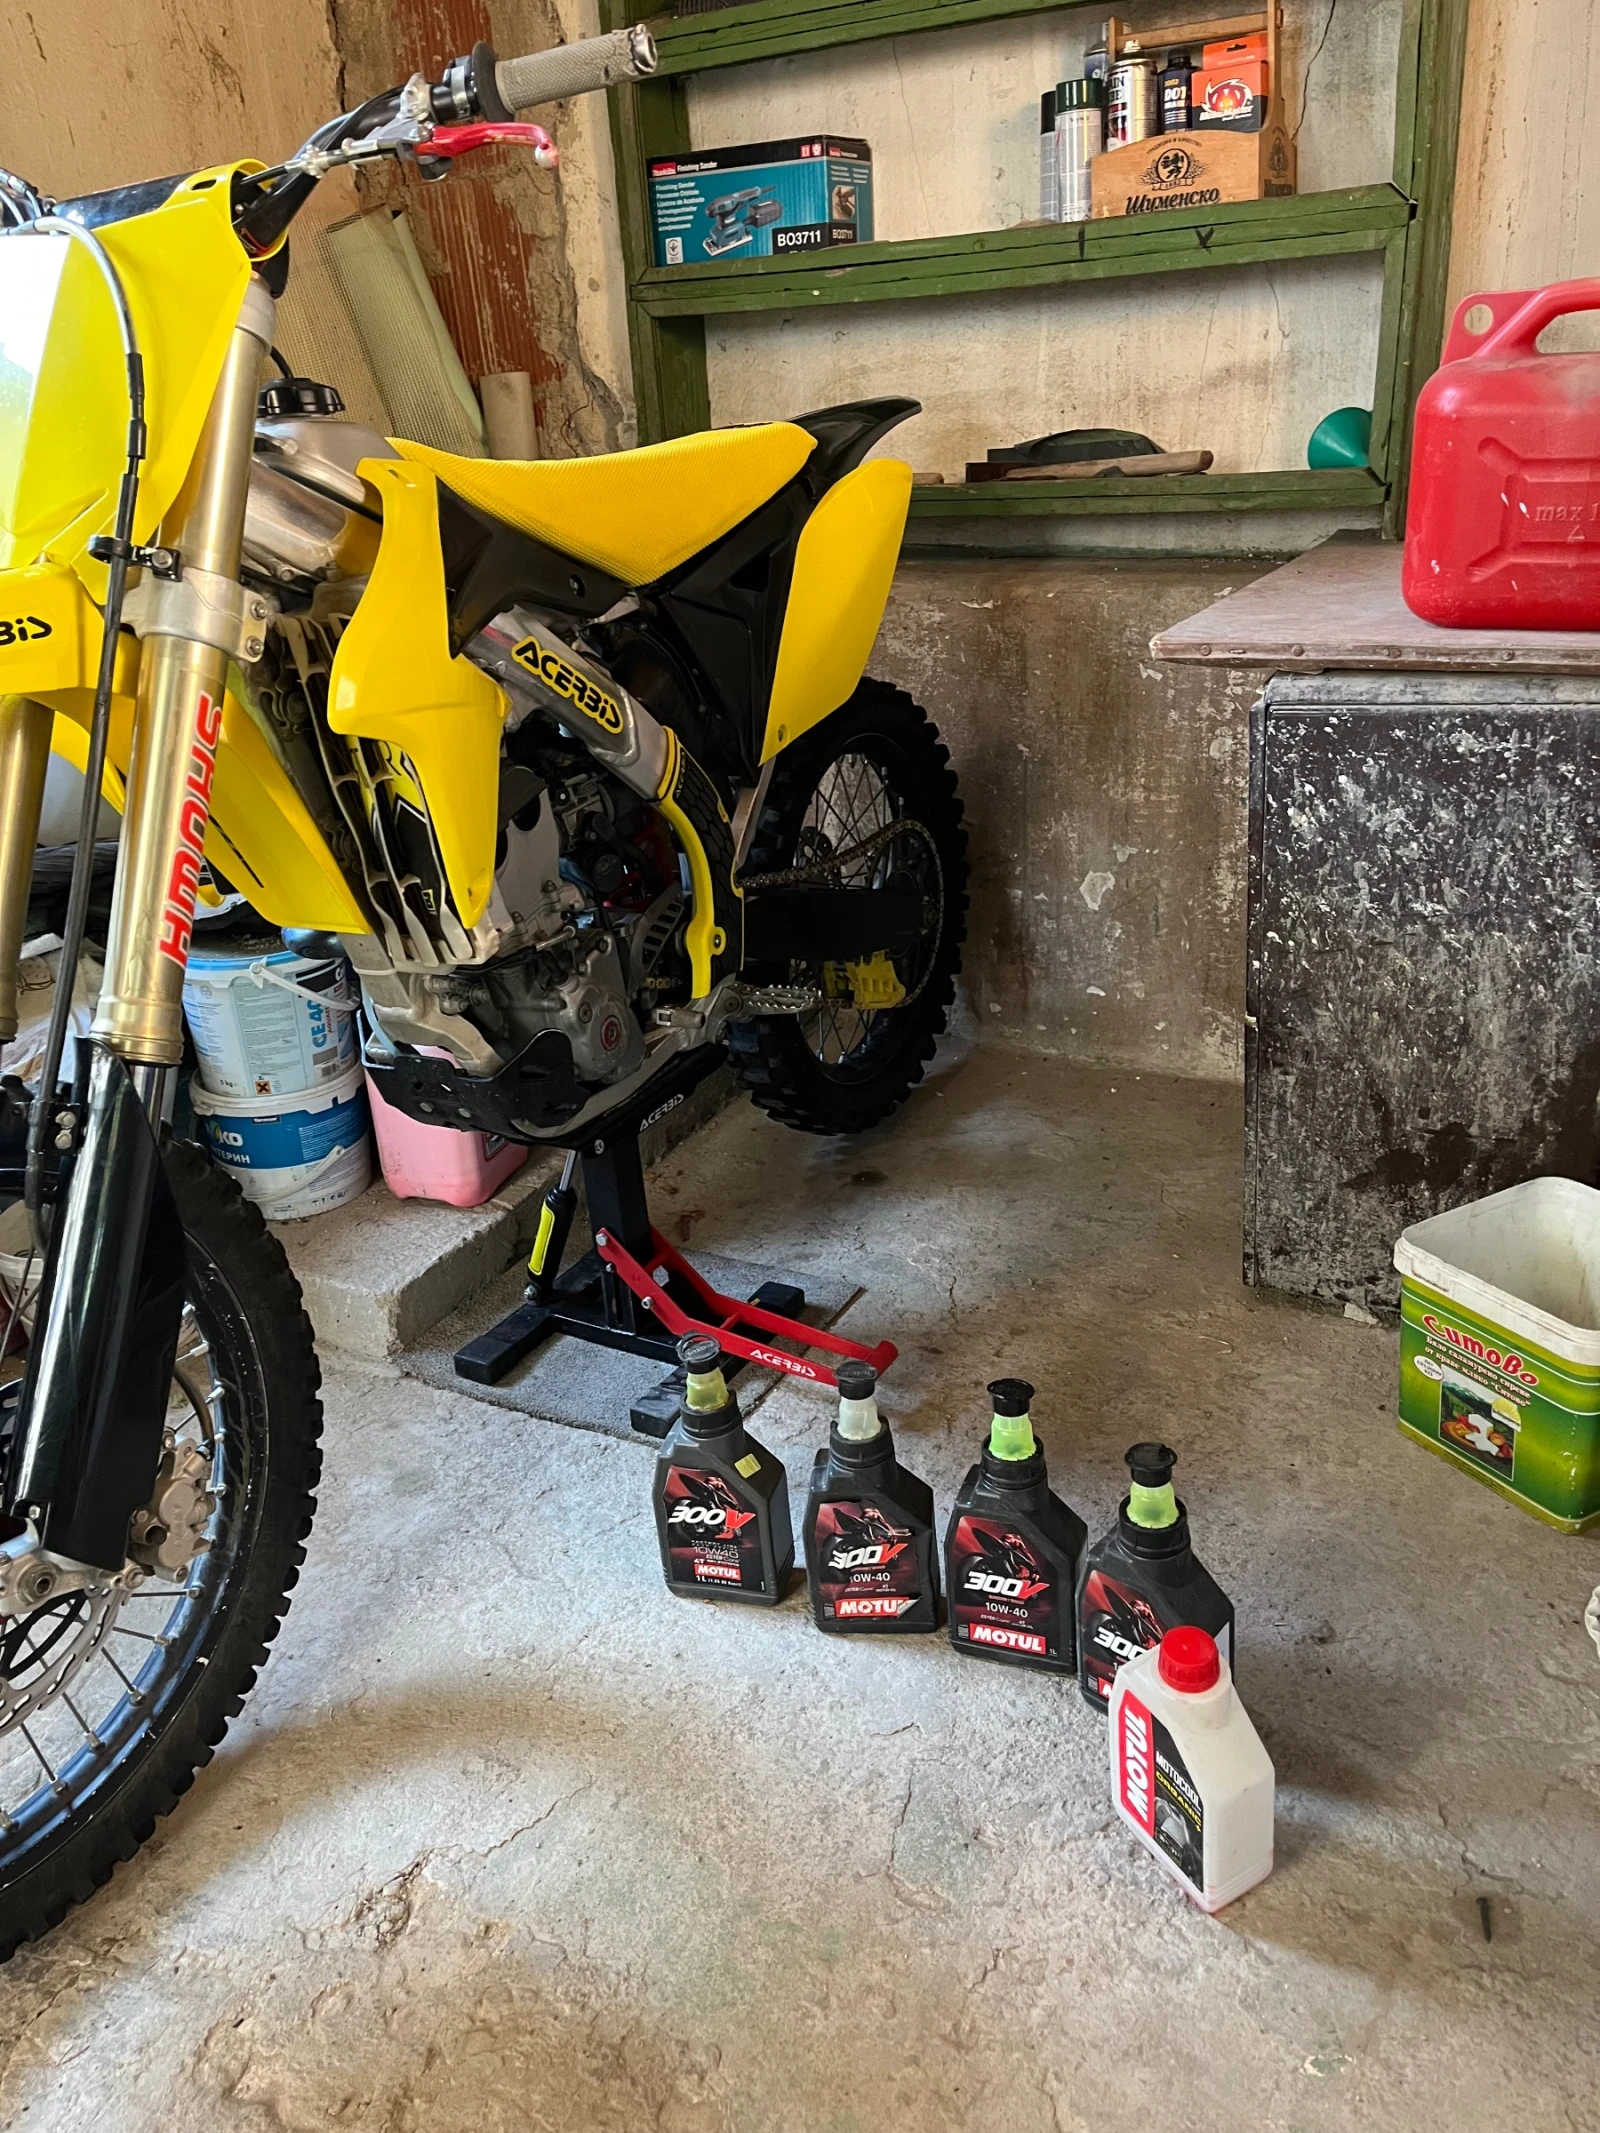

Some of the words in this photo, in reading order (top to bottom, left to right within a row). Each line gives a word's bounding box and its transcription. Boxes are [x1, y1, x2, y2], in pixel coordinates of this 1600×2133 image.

[1125, 187, 1220, 215] Шуменско
[777, 230, 821, 247] BO3711
[515, 641, 621, 729] ACERBIS
[750, 1349, 816, 1378] ACERBIS
[668, 1505, 756, 1530] 300V
[693, 1546, 739, 1559] 10W40
[828, 1543, 908, 1569] 300V
[697, 1565, 739, 1578] MOTUL
[963, 1571, 1050, 1600] 300V
[985, 1602, 1028, 1618] 10W-40
[973, 1626, 1042, 1652] MOTUL
[1093, 1626, 1149, 1661] 300
[1124, 1704, 1148, 1824] MOTUL
[1155, 1750, 1202, 1812] MOTOCOOL
[1155, 1770, 1202, 1826] ORGANIC
